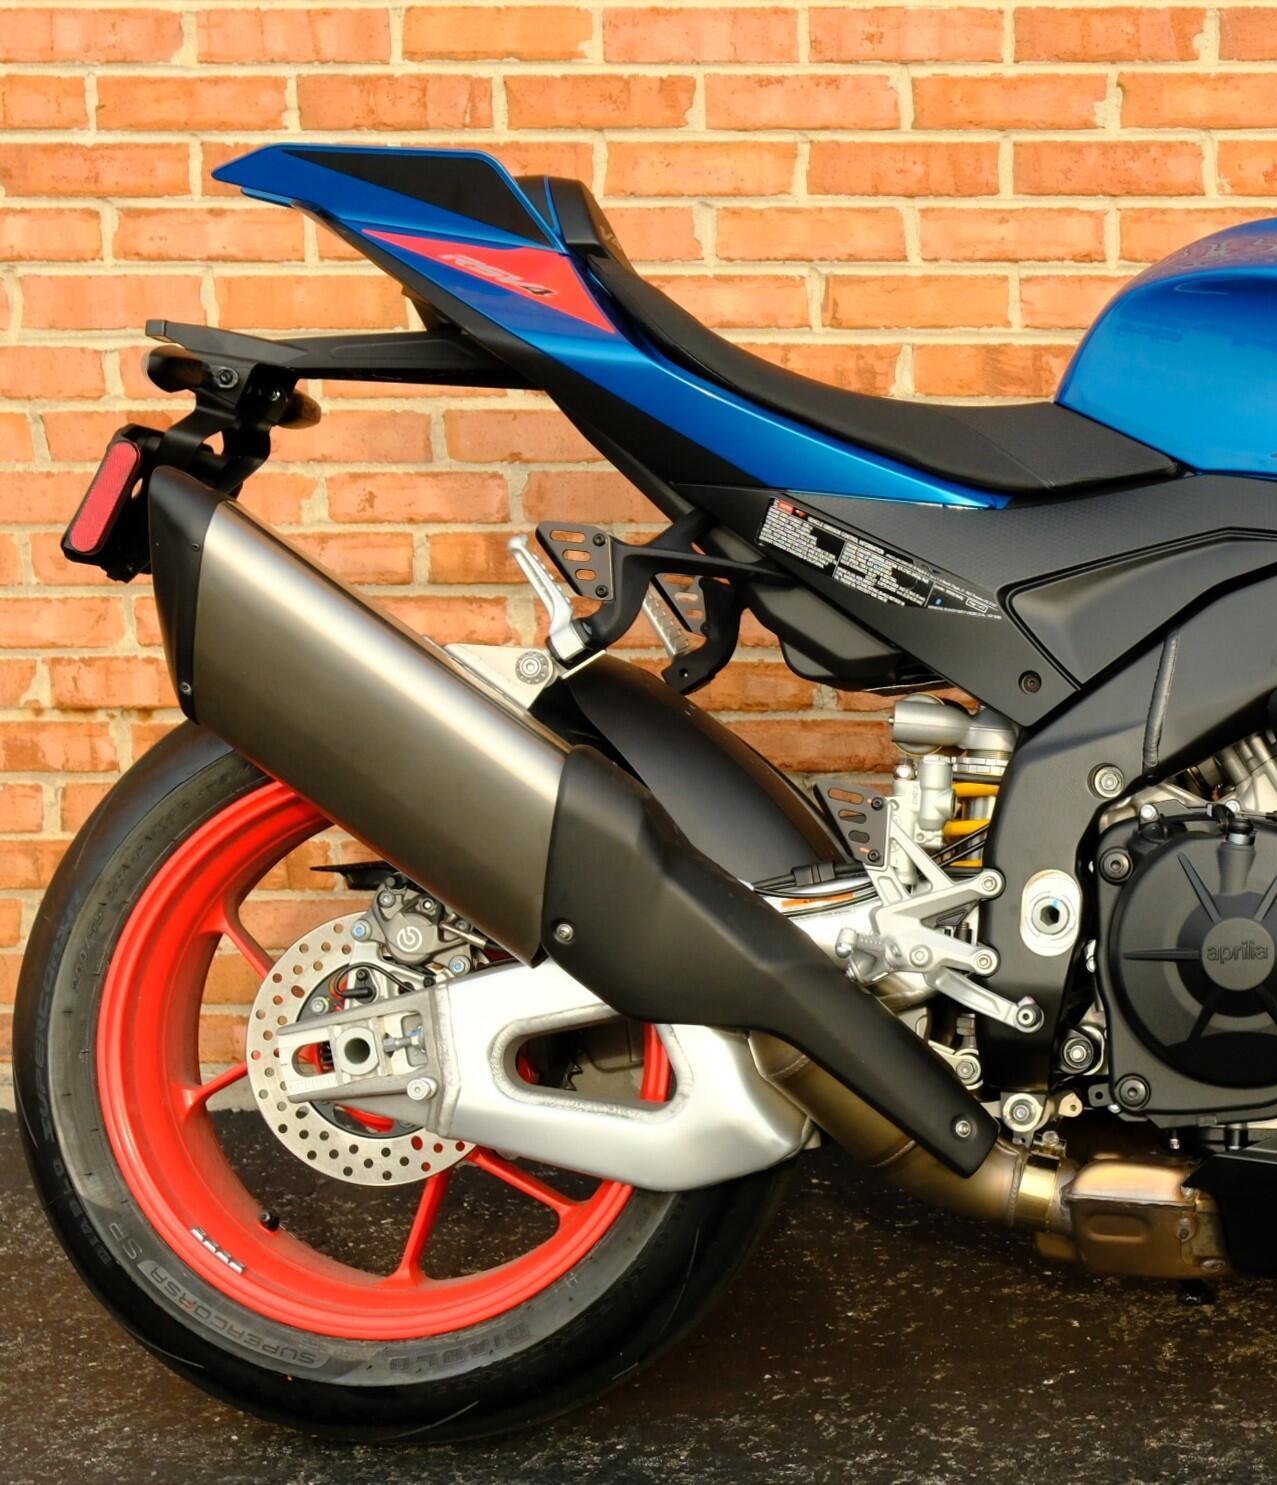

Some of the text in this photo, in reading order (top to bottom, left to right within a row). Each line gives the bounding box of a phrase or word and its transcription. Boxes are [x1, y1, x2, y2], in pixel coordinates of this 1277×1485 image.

[1206, 940, 1269, 966] aprilia
[108, 1222, 318, 1365] SUPERCORSA SP
